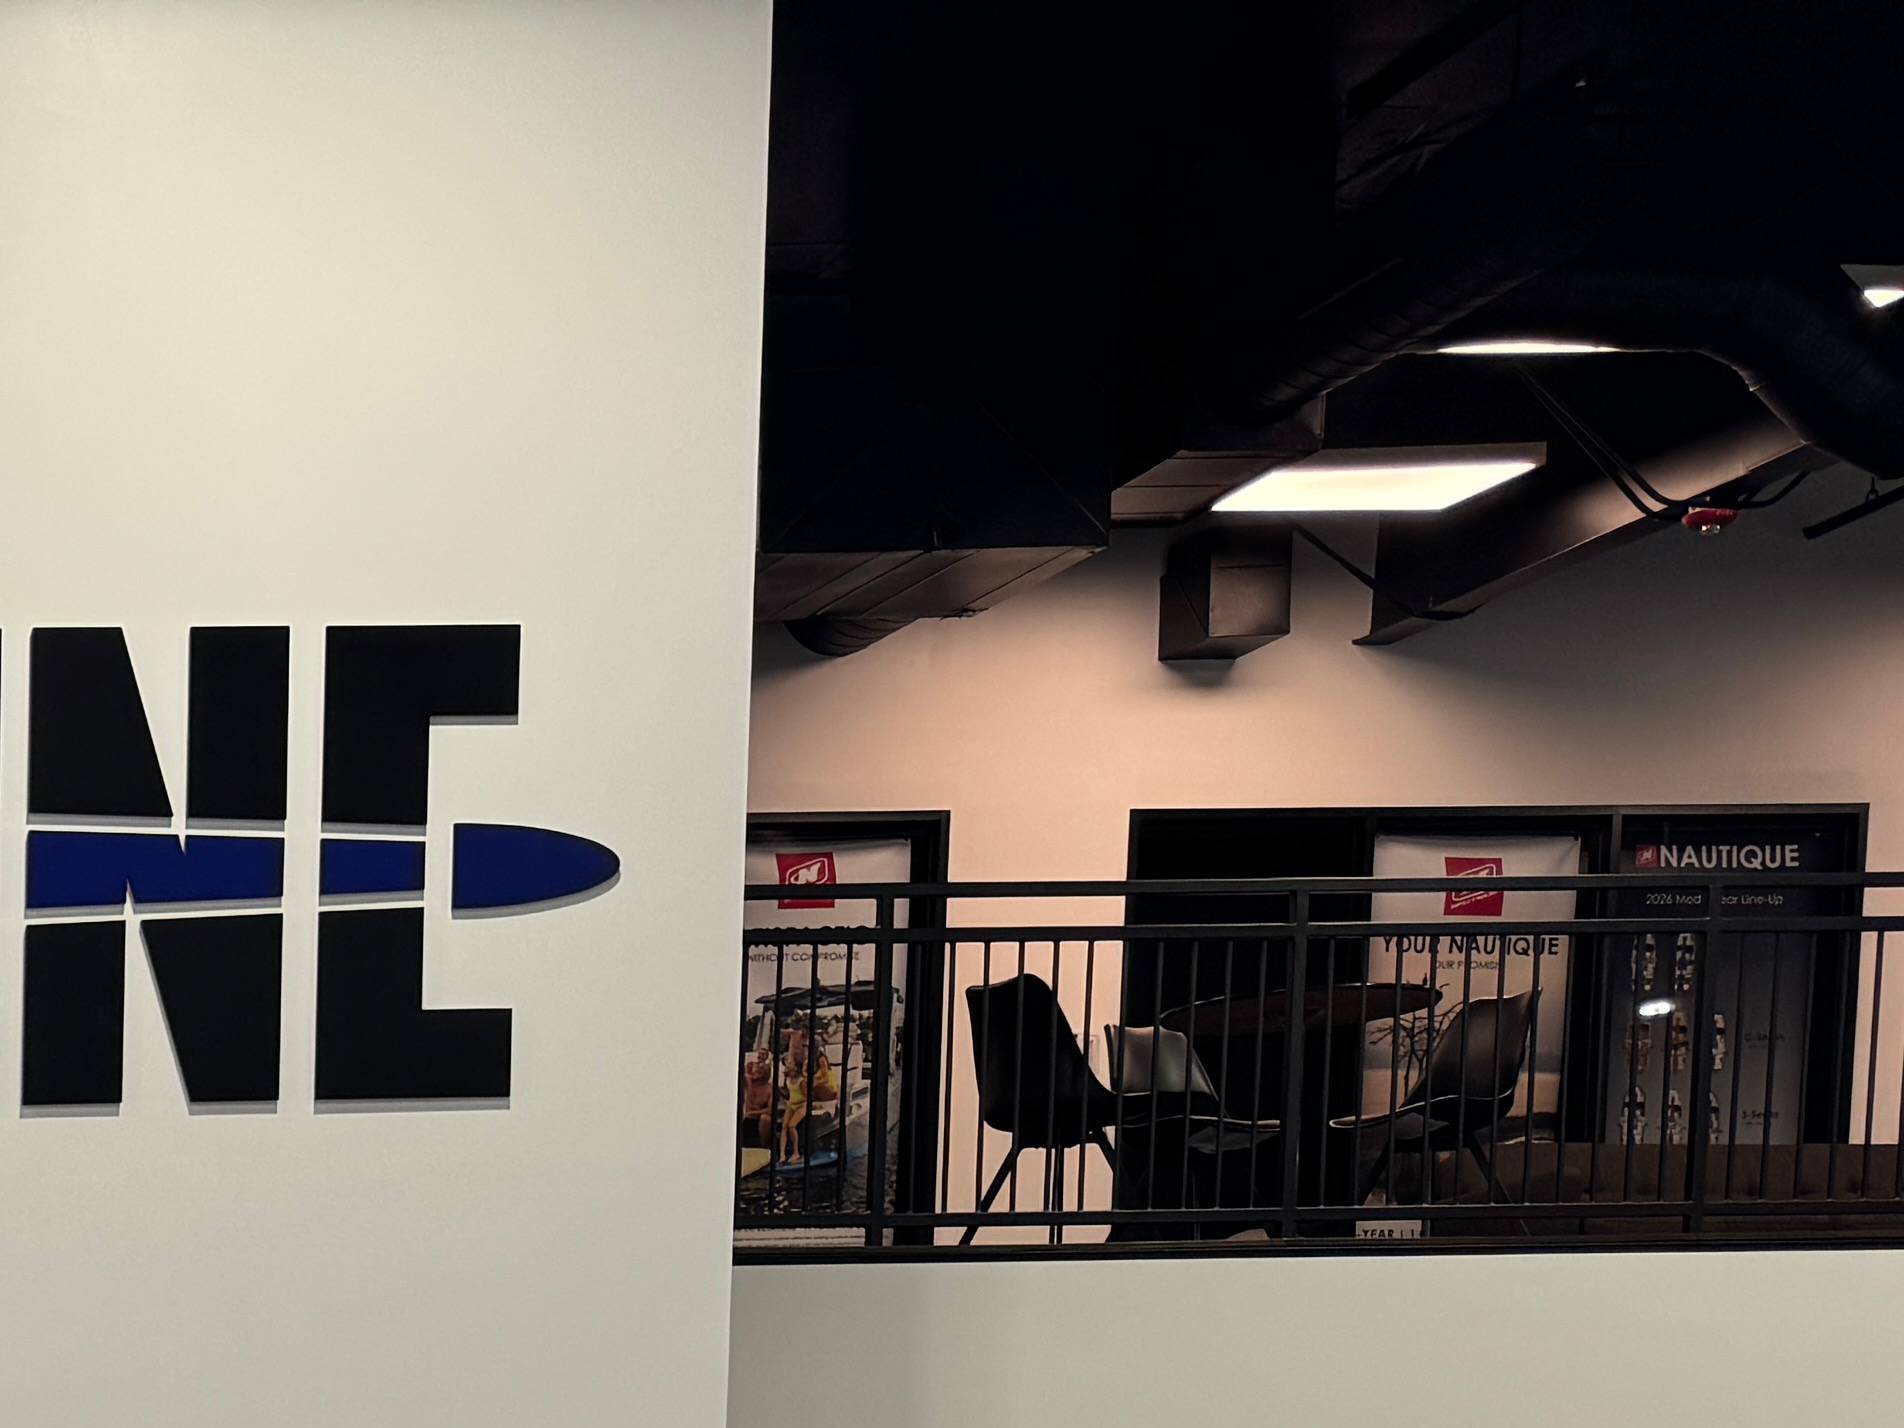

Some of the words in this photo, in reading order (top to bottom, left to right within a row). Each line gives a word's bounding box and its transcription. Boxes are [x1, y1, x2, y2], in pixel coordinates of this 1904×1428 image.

[1660, 844, 1800, 869] NAUTIQUE
[1675, 894, 1702, 905] Mod
[1720, 895, 1738, 905] ear
[1448, 936, 1560, 956] NAUIQUE
